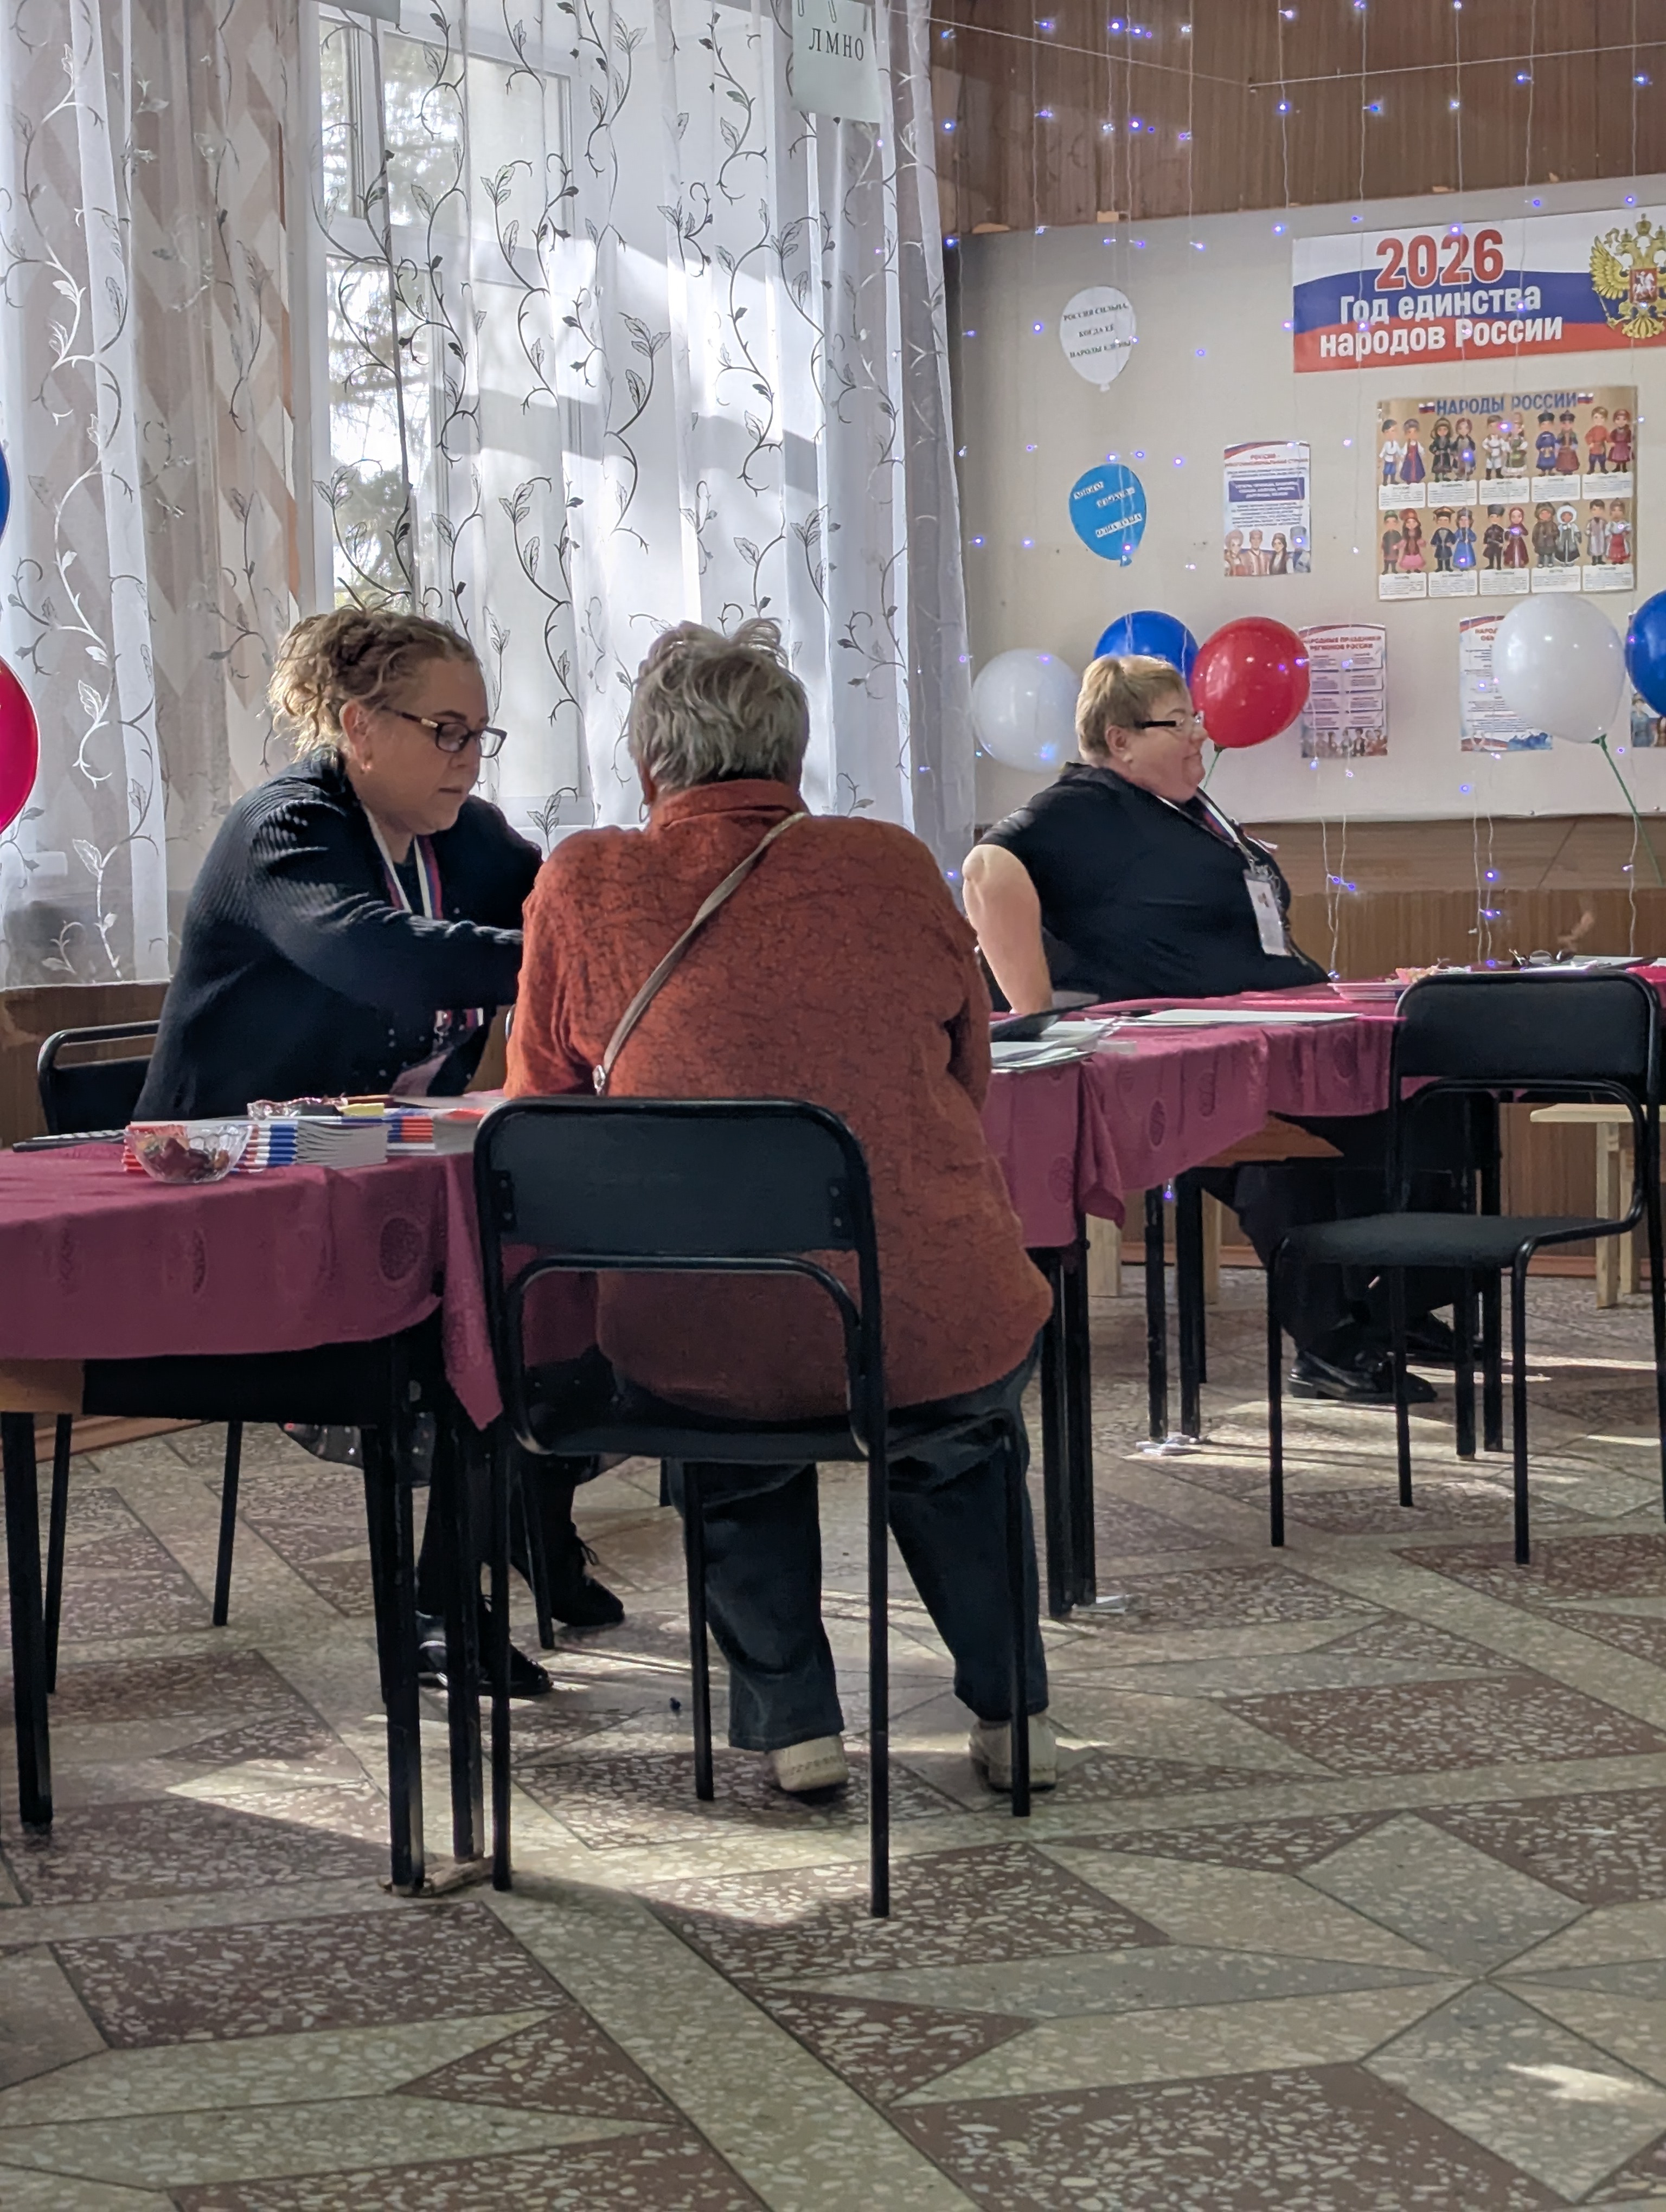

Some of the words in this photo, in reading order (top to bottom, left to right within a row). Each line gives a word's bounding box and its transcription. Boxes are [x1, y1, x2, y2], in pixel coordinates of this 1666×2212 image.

[809, 28, 864, 61] ЛМНО
[1375, 229, 1504, 292] 2026
[1341, 295, 1389, 325] Год
[1398, 286, 1541, 321] единства
[1320, 325, 1446, 362] народов
[1456, 316, 1563, 348] России
[1436, 396, 1504, 415] НАРОДЫ
[1512, 392, 1577, 411] РОССИИ
